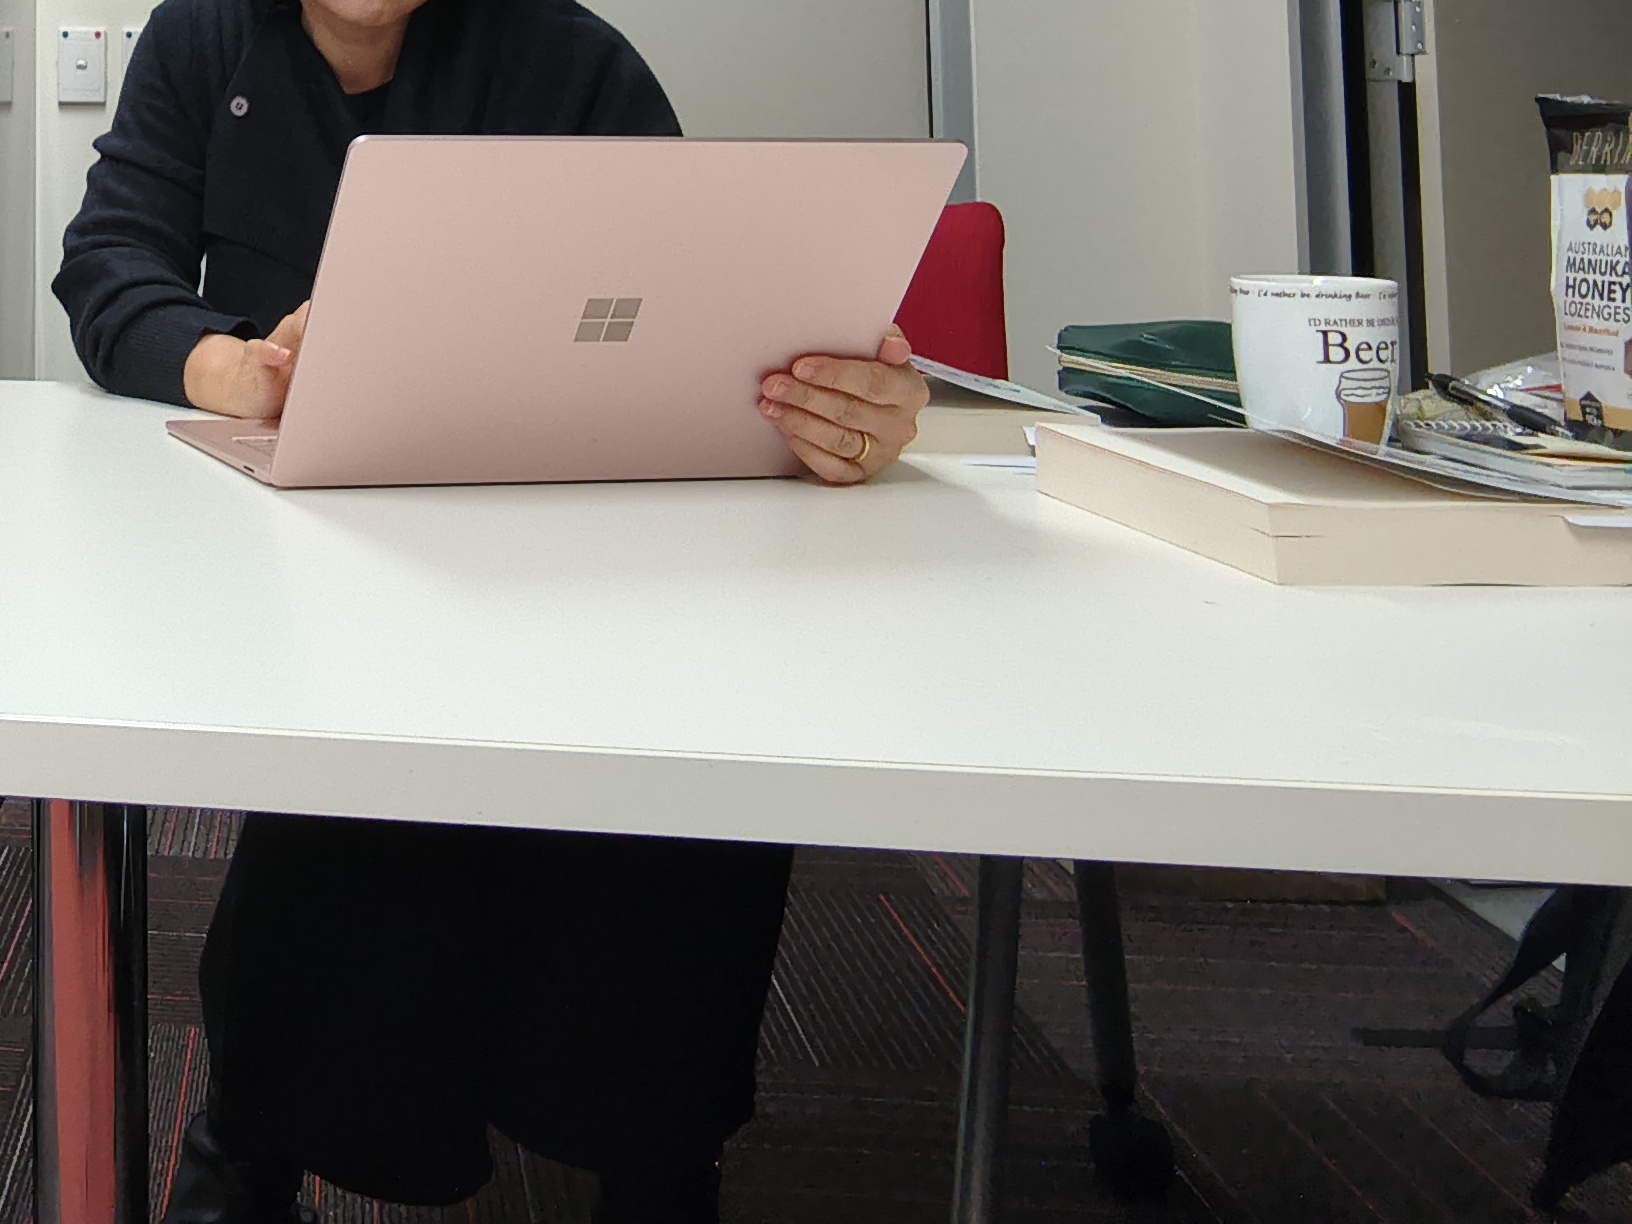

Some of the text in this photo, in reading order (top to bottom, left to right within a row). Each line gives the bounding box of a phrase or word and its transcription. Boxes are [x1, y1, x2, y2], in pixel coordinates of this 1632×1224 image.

[1565, 256, 1632, 278] MANUKA
[1300, 289, 1311, 299] be
[1314, 289, 1353, 302] drinking
[1564, 276, 1632, 304] HONEY
[1307, 317, 1323, 327] I'D
[1323, 317, 1364, 328] RATHER
[1563, 299, 1631, 324] LOZENGES
[1315, 329, 1398, 366] Beer
